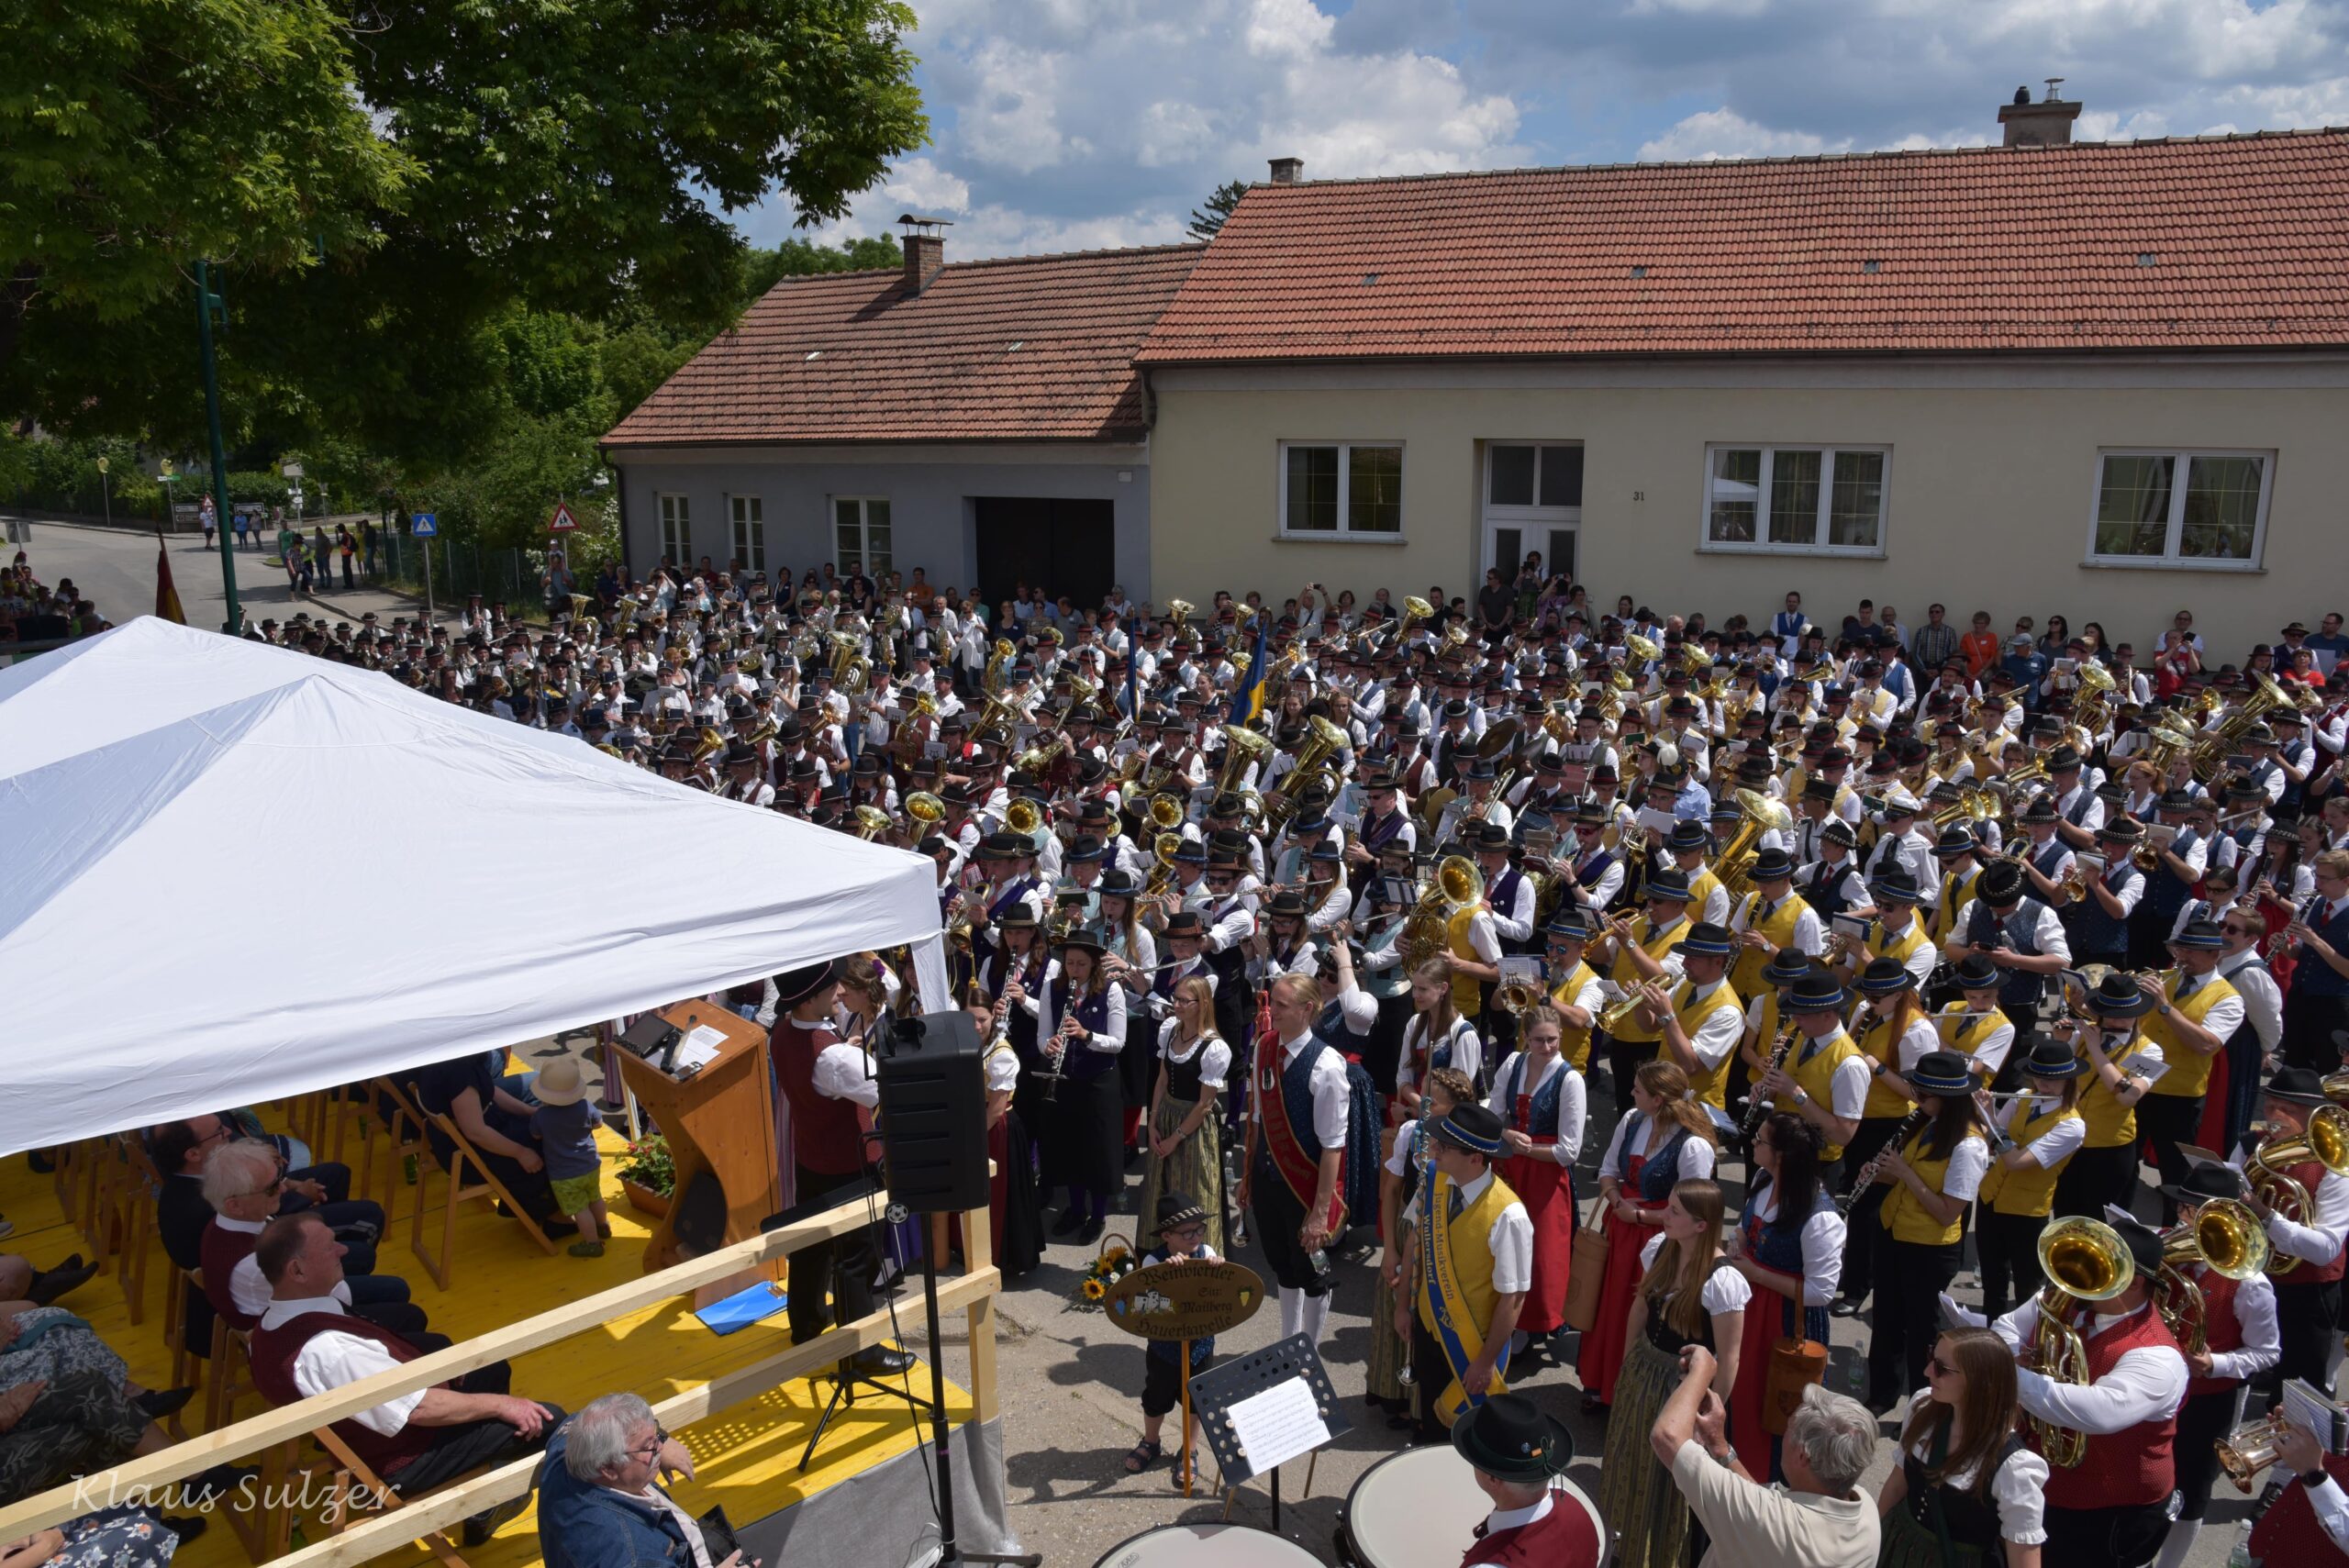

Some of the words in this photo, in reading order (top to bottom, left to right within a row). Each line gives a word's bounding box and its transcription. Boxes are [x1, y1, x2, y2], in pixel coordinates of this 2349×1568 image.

[1632, 491, 1645, 501] 31
[1423, 1214, 1436, 1285] Wullersdorf
[1433, 1193, 1453, 1300] Jugend-Musikverein
[1181, 1301, 1232, 1314] Mailberg
[1136, 1315, 1231, 1337] Hauerkapelle
